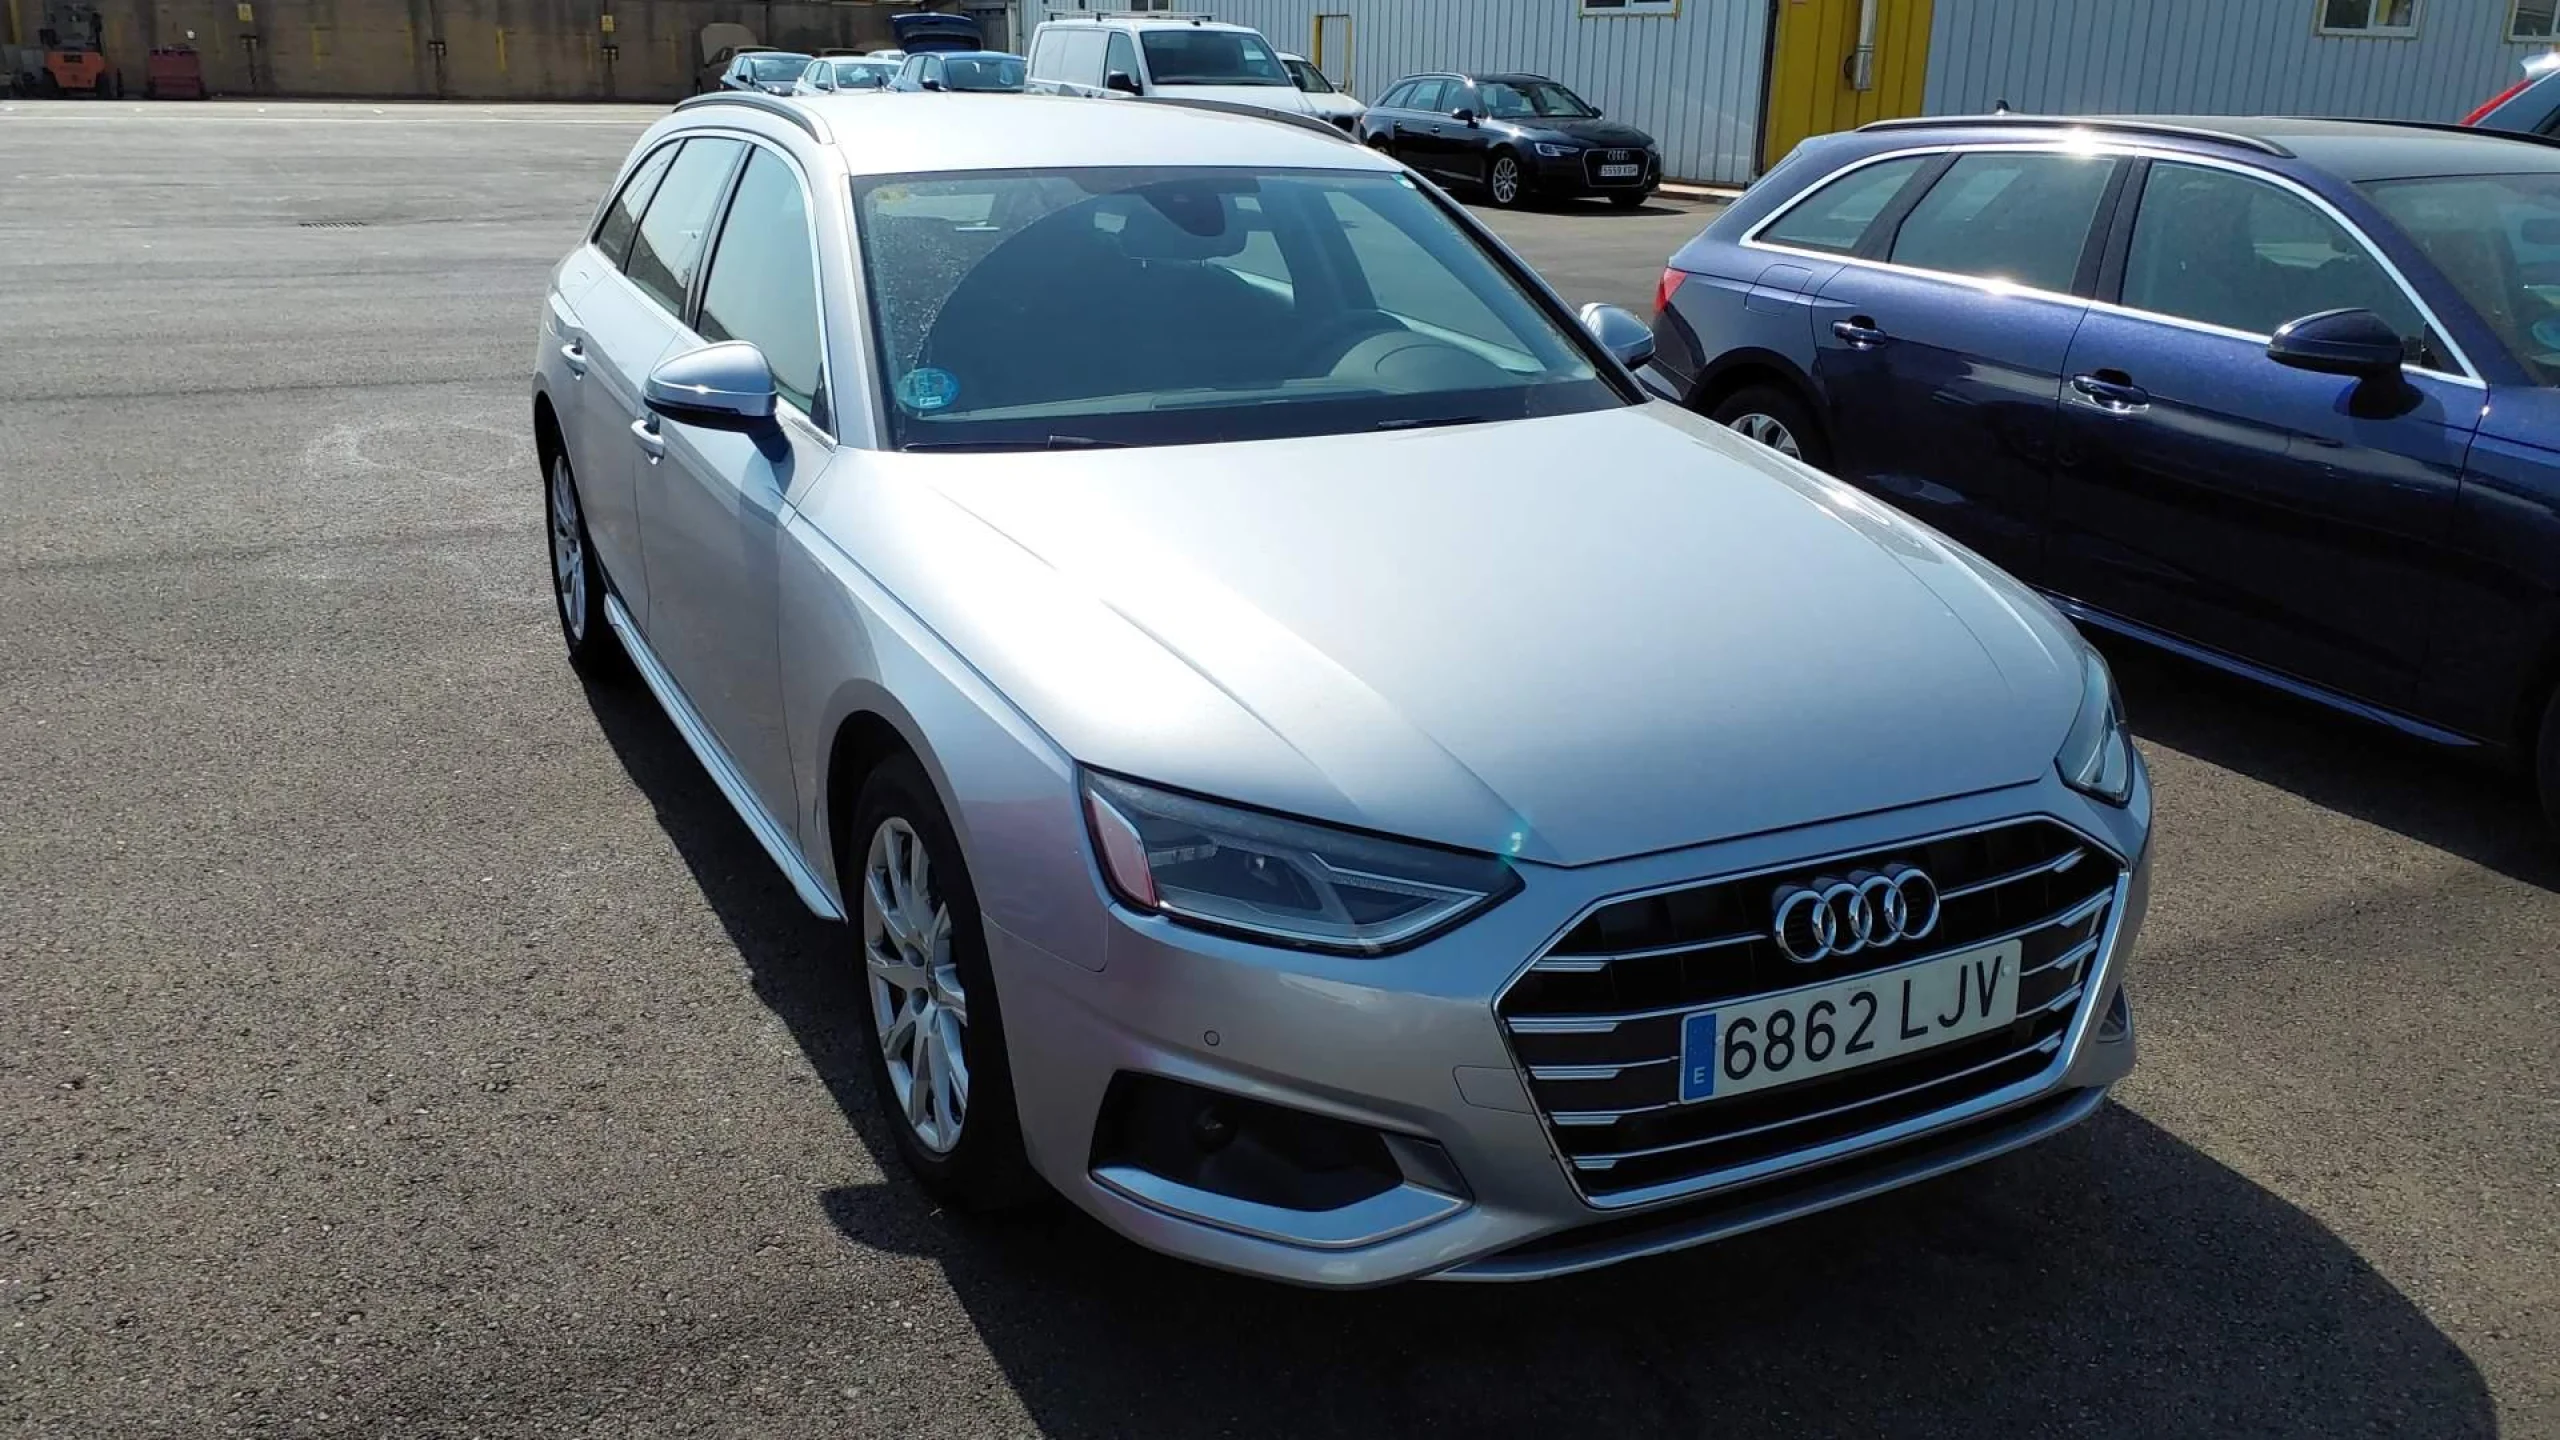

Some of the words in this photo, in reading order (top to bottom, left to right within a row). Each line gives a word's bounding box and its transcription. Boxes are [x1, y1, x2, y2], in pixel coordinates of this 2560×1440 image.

[1723, 990, 1879, 1081] 6862
[1899, 955, 2003, 1041] LJV
[1692, 1065, 1705, 1085] E
